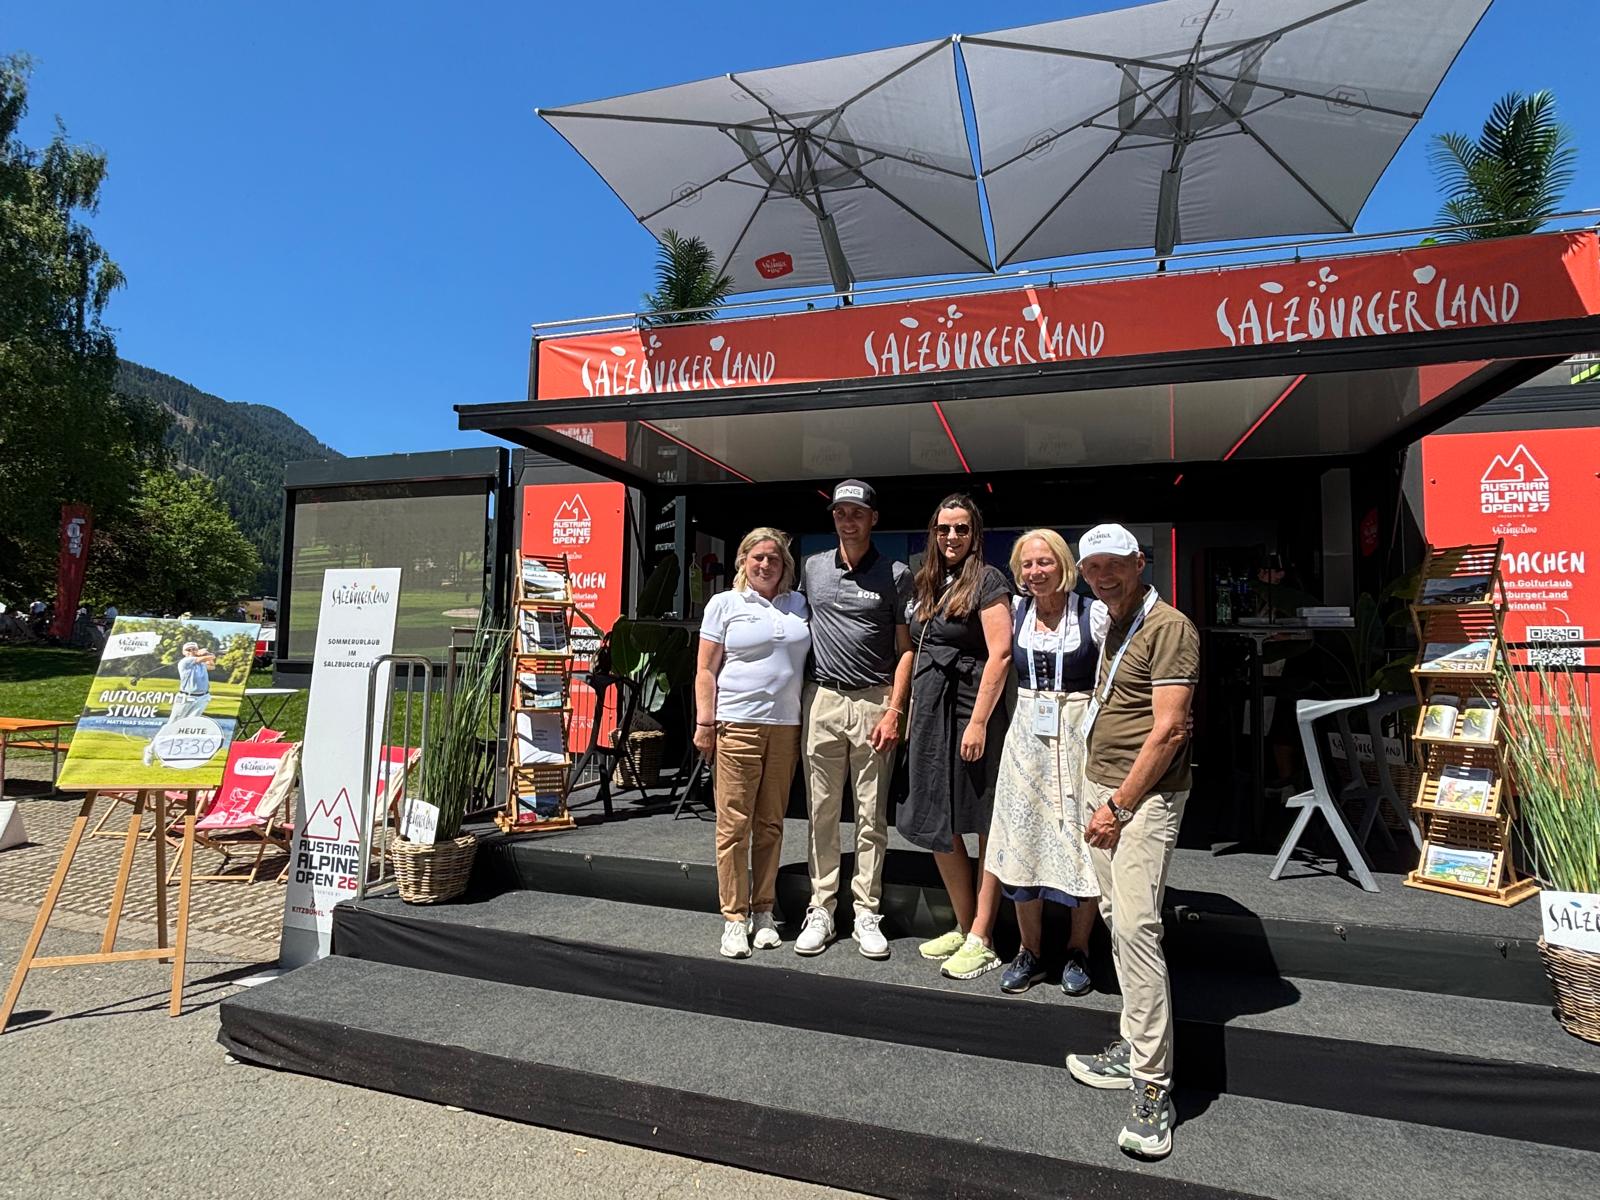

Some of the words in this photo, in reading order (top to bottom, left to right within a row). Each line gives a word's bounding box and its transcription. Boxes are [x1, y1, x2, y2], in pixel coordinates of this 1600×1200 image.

[1480, 482, 1549, 492] AUSTRIAN
[837, 488, 862, 497] PING
[1480, 490, 1550, 504] ALPINE
[1481, 503, 1524, 513] OPEN
[1528, 502, 1550, 512] 27
[553, 528, 591, 536] ALPINE
[553, 536, 577, 544] OPEN
[578, 536, 590, 544] 27
[857, 590, 880, 600] BOSS
[328, 638, 380, 646] SOMMERURLAUB
[106, 704, 159, 718] STUNDE
[299, 840, 359, 857] AUSTRIAN
[297, 852, 359, 875] ALPINE
[295, 870, 334, 887] OPEN
[337, 875, 357, 890] 26
